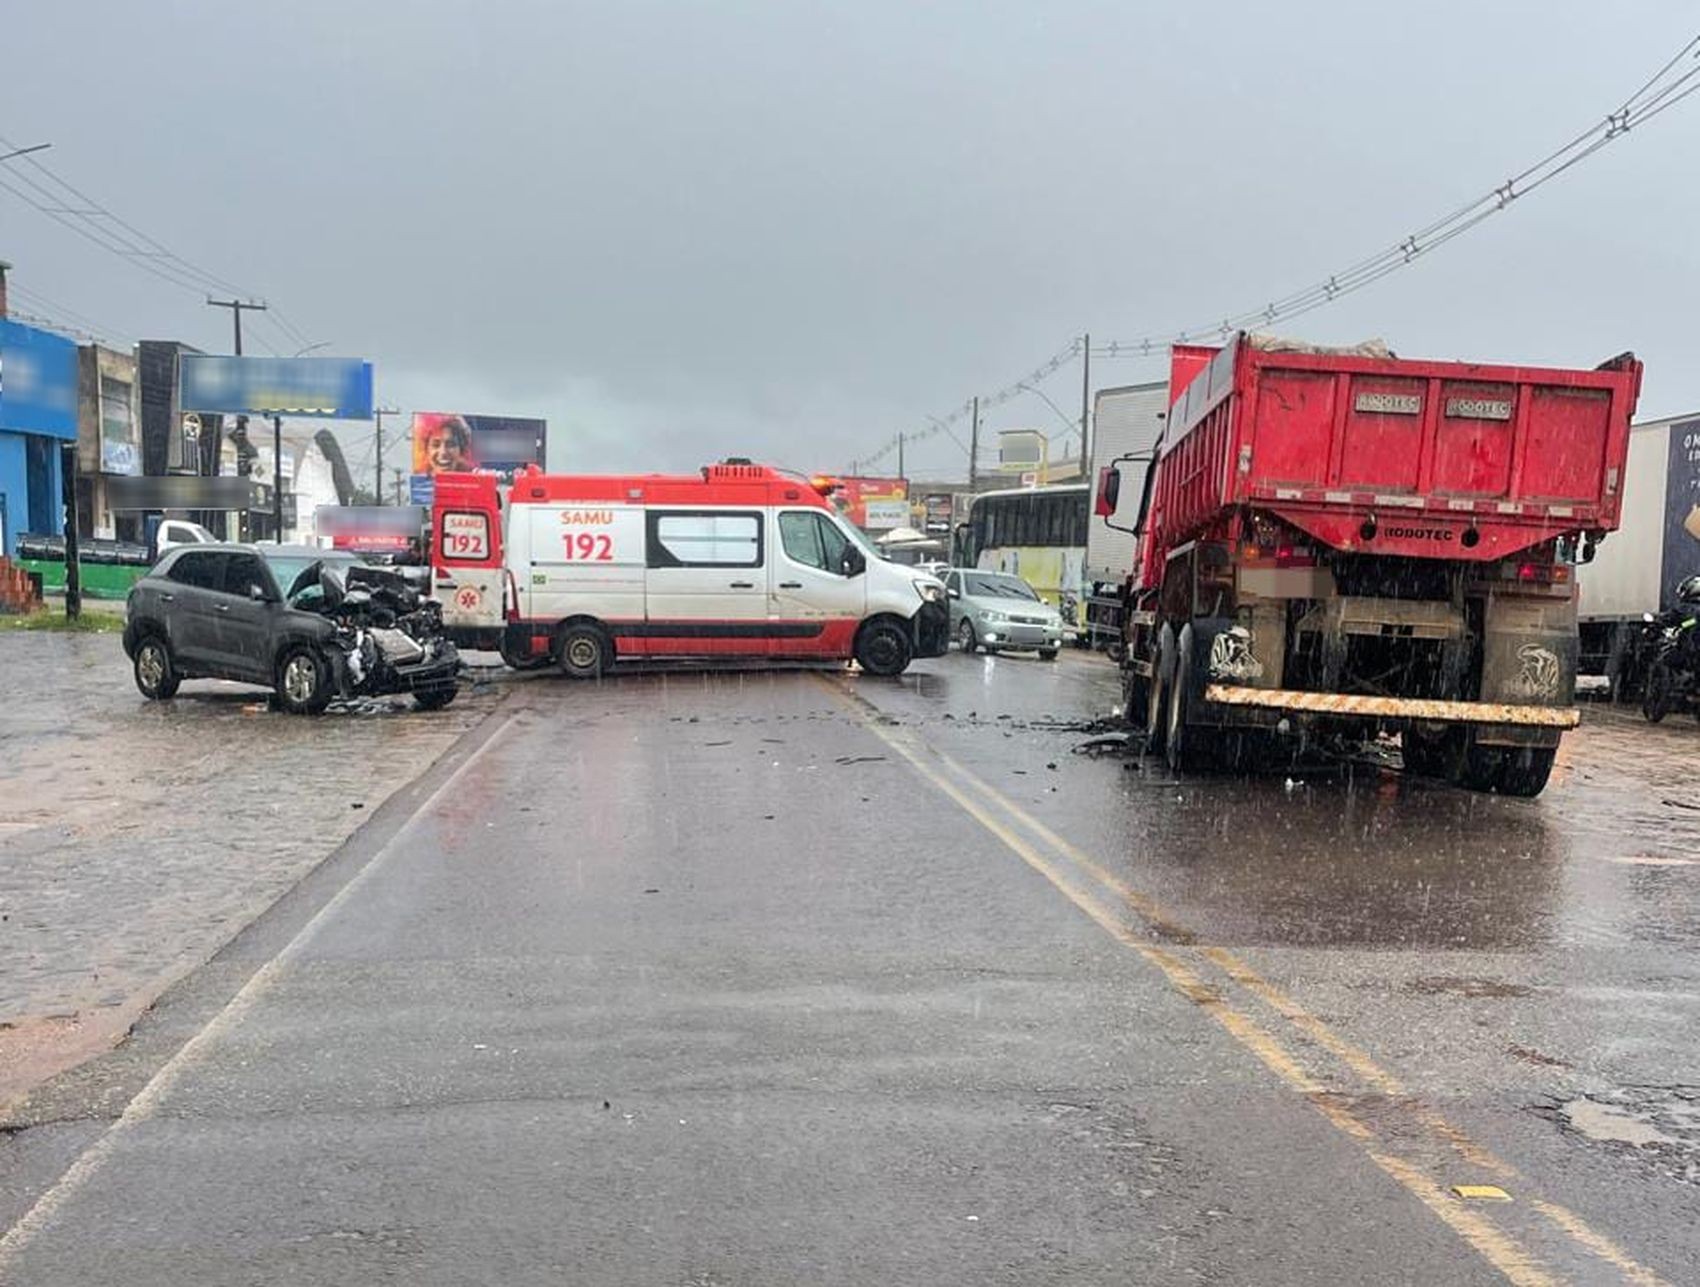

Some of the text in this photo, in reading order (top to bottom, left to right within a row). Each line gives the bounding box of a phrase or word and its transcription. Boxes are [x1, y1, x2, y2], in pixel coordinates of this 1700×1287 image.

[450, 518, 483, 529] SAMU
[560, 511, 613, 525] SAMU
[450, 535, 482, 553] 192
[562, 533, 613, 560] 192
